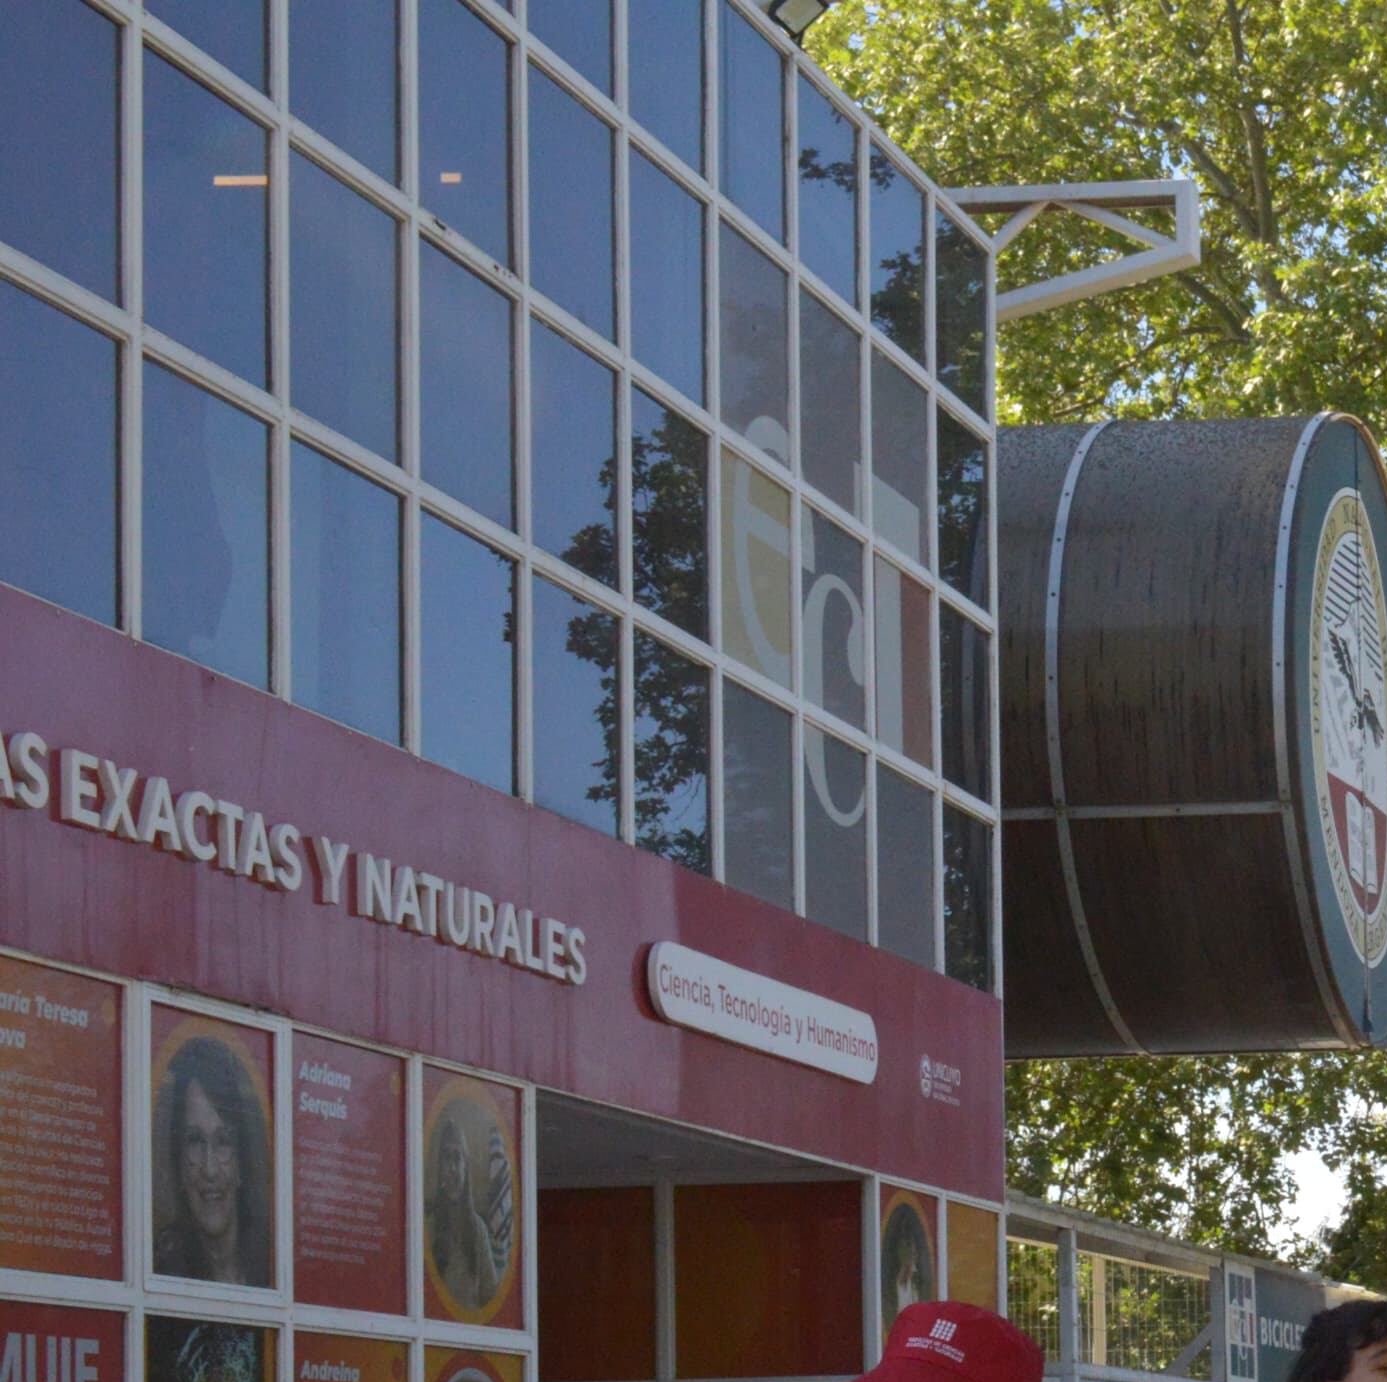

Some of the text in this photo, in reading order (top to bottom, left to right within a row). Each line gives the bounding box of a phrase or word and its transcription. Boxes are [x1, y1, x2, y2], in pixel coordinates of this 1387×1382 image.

[61, 748, 301, 891] EXACTAS
[310, 836, 349, 904] Y
[357, 852, 587, 986] NATURALES
[36, 996, 89, 1028] Teresa
[659, 964, 714, 1014] Ciencia,
[795, 1018, 803, 1044] y
[807, 1016, 876, 1062] Humanismo
[299, 1060, 351, 1090] Adriana
[299, 1091, 348, 1120] Serquis
